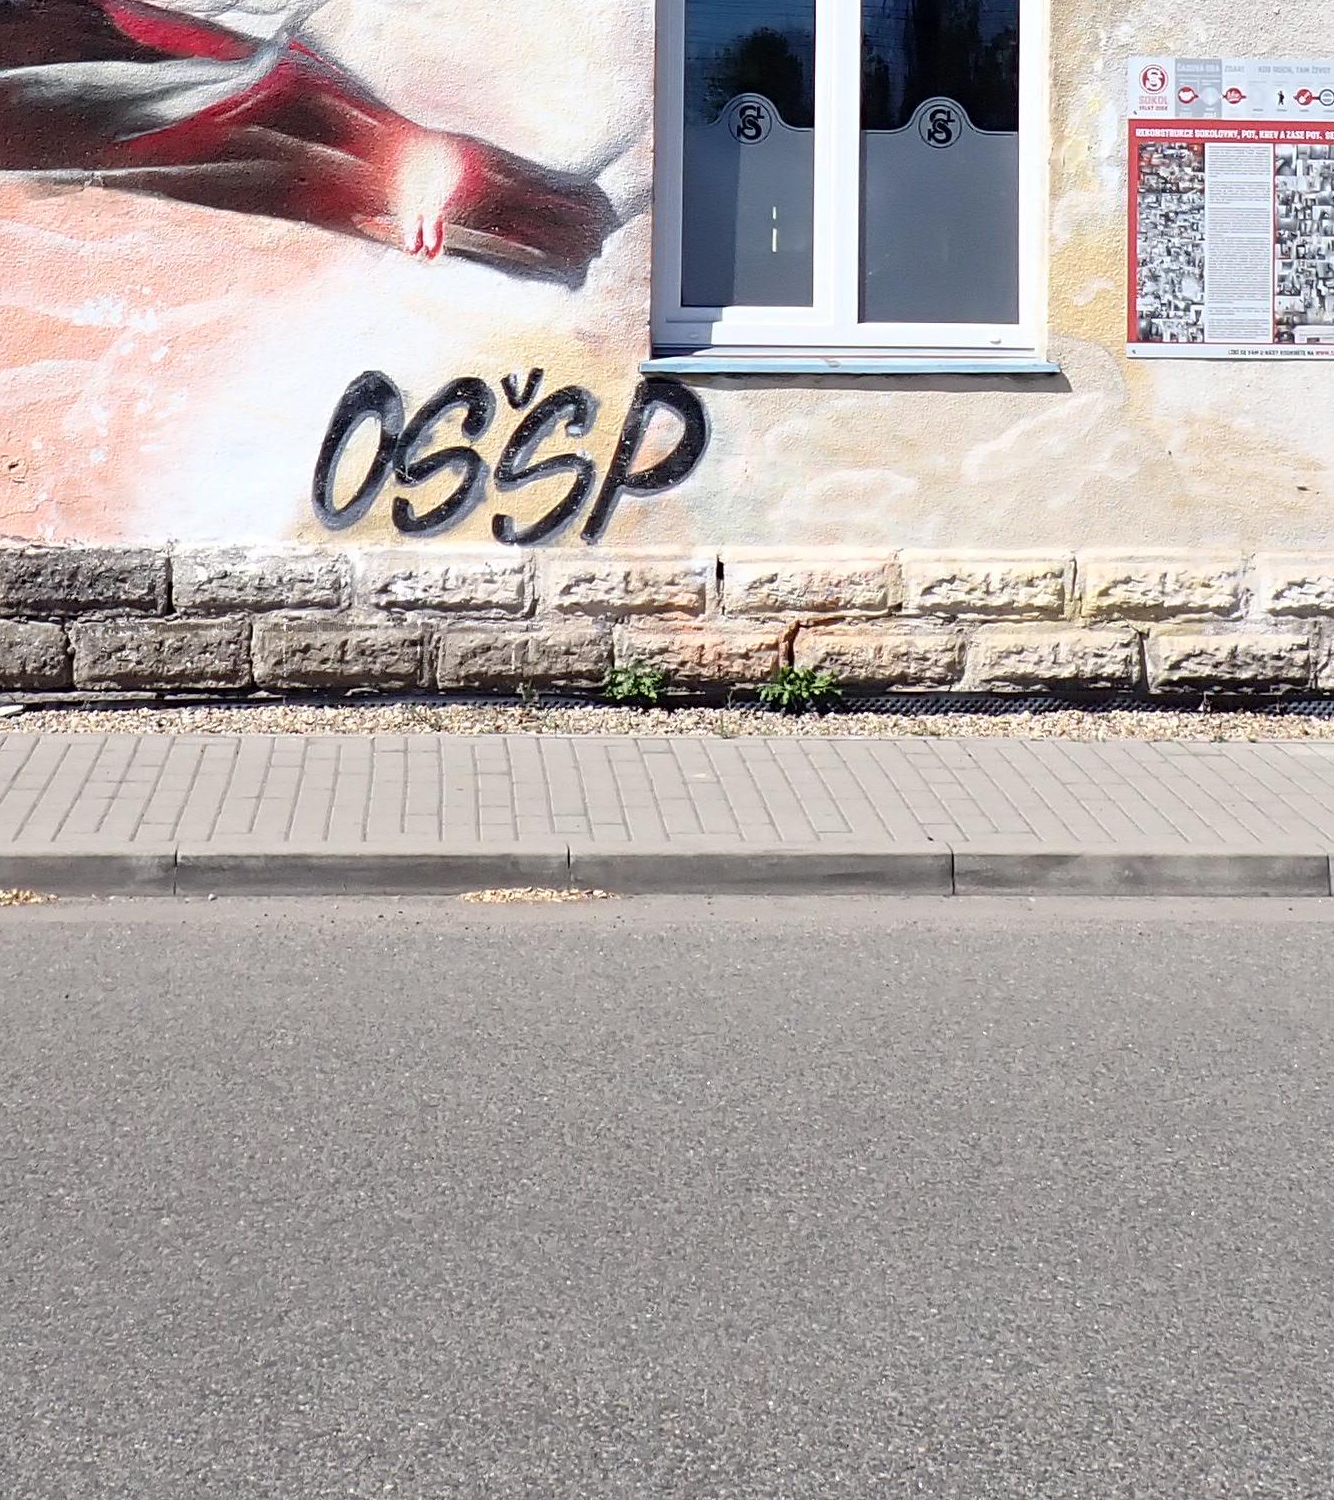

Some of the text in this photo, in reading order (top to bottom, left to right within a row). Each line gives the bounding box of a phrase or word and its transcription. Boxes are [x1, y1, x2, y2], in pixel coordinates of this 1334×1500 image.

[1139, 96, 1168, 105] SOKOL
[1135, 129, 1193, 137] REKONSTRUKCE
[313, 368, 712, 545] OSŠP
